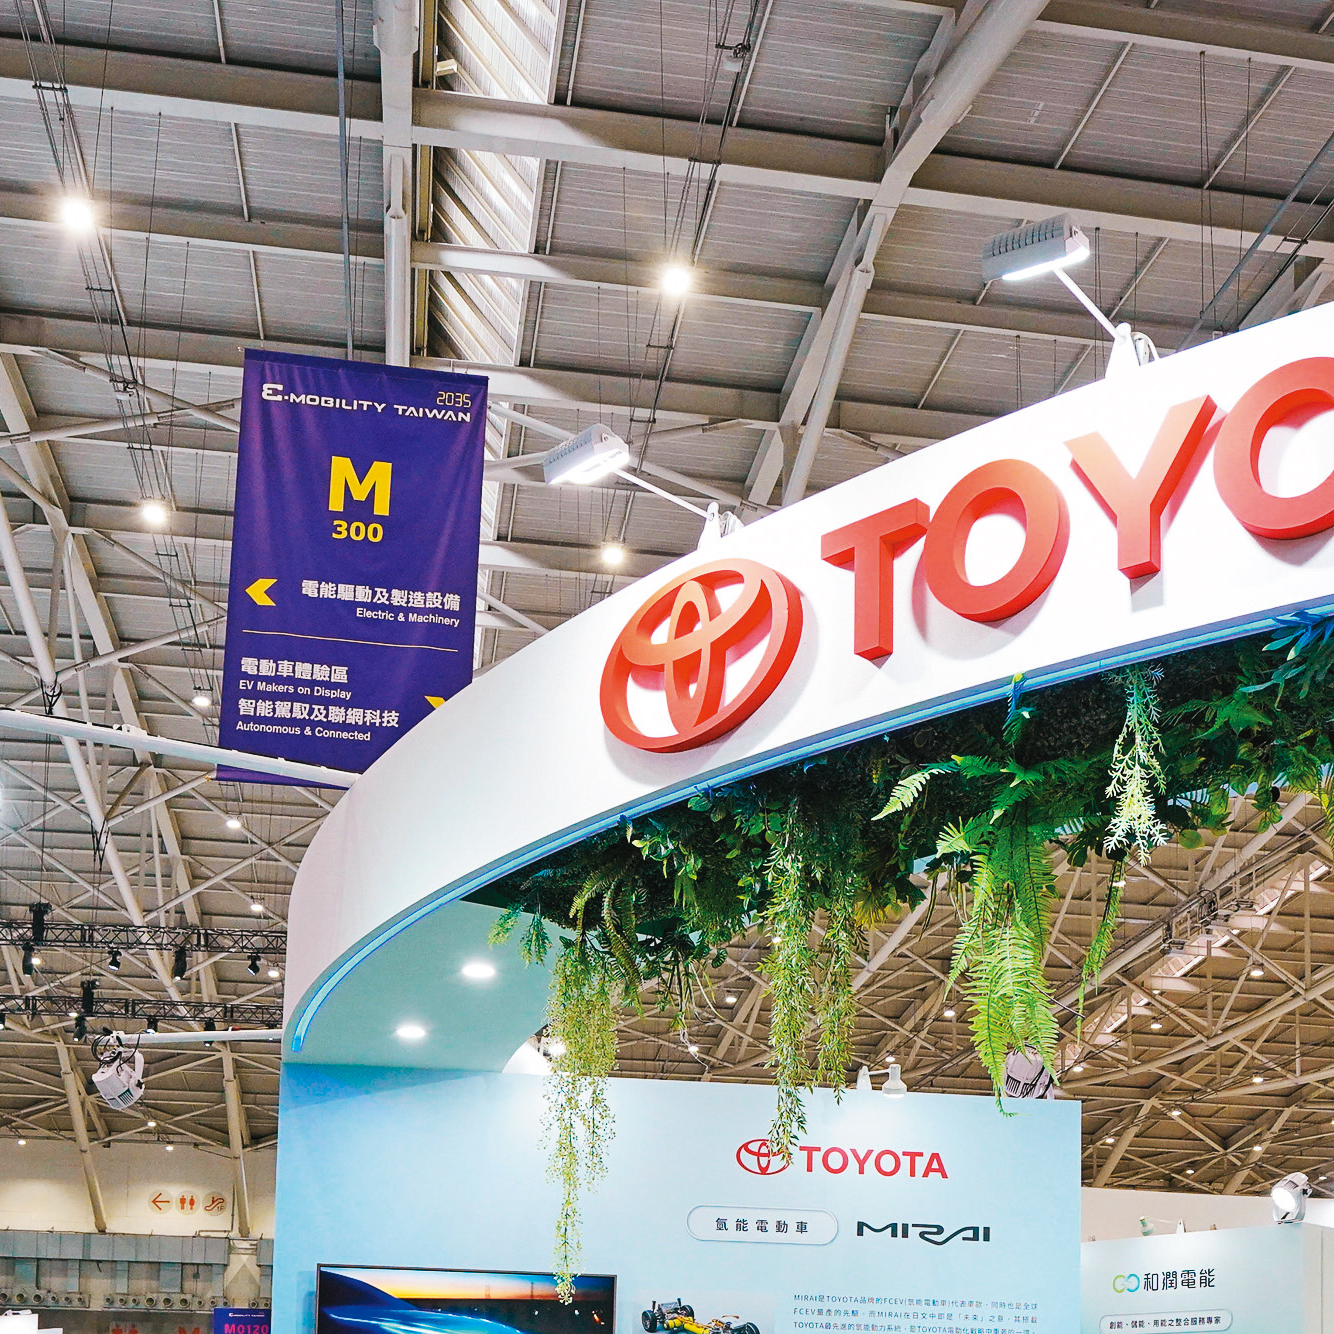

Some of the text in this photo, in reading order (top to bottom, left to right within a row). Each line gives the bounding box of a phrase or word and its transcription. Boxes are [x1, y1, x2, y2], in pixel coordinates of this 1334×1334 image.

[436, 391, 472, 409] 2035
[394, 404, 471, 423] TAIWAN
[328, 455, 393, 517] M
[331, 519, 384, 543] 300
[301, 579, 461, 612] 電能驅動及製造設備
[356, 607, 460, 628] Electric & Machinery
[240, 657, 349, 683] 電動車體驗區
[239, 680, 352, 701] EV Makers on Display
[238, 698, 400, 728] 智能駕馭及聯網科技
[236, 720, 371, 741] Autonomous & Connected
[798, 1145, 949, 1179] TOYOTA
[715, 1217, 809, 1235] 氫能電動車
[857, 1220, 991, 1246] MIRAI
[1143, 1268, 1216, 1292] 和潤電能
[224, 1324, 269, 1334] M0120
